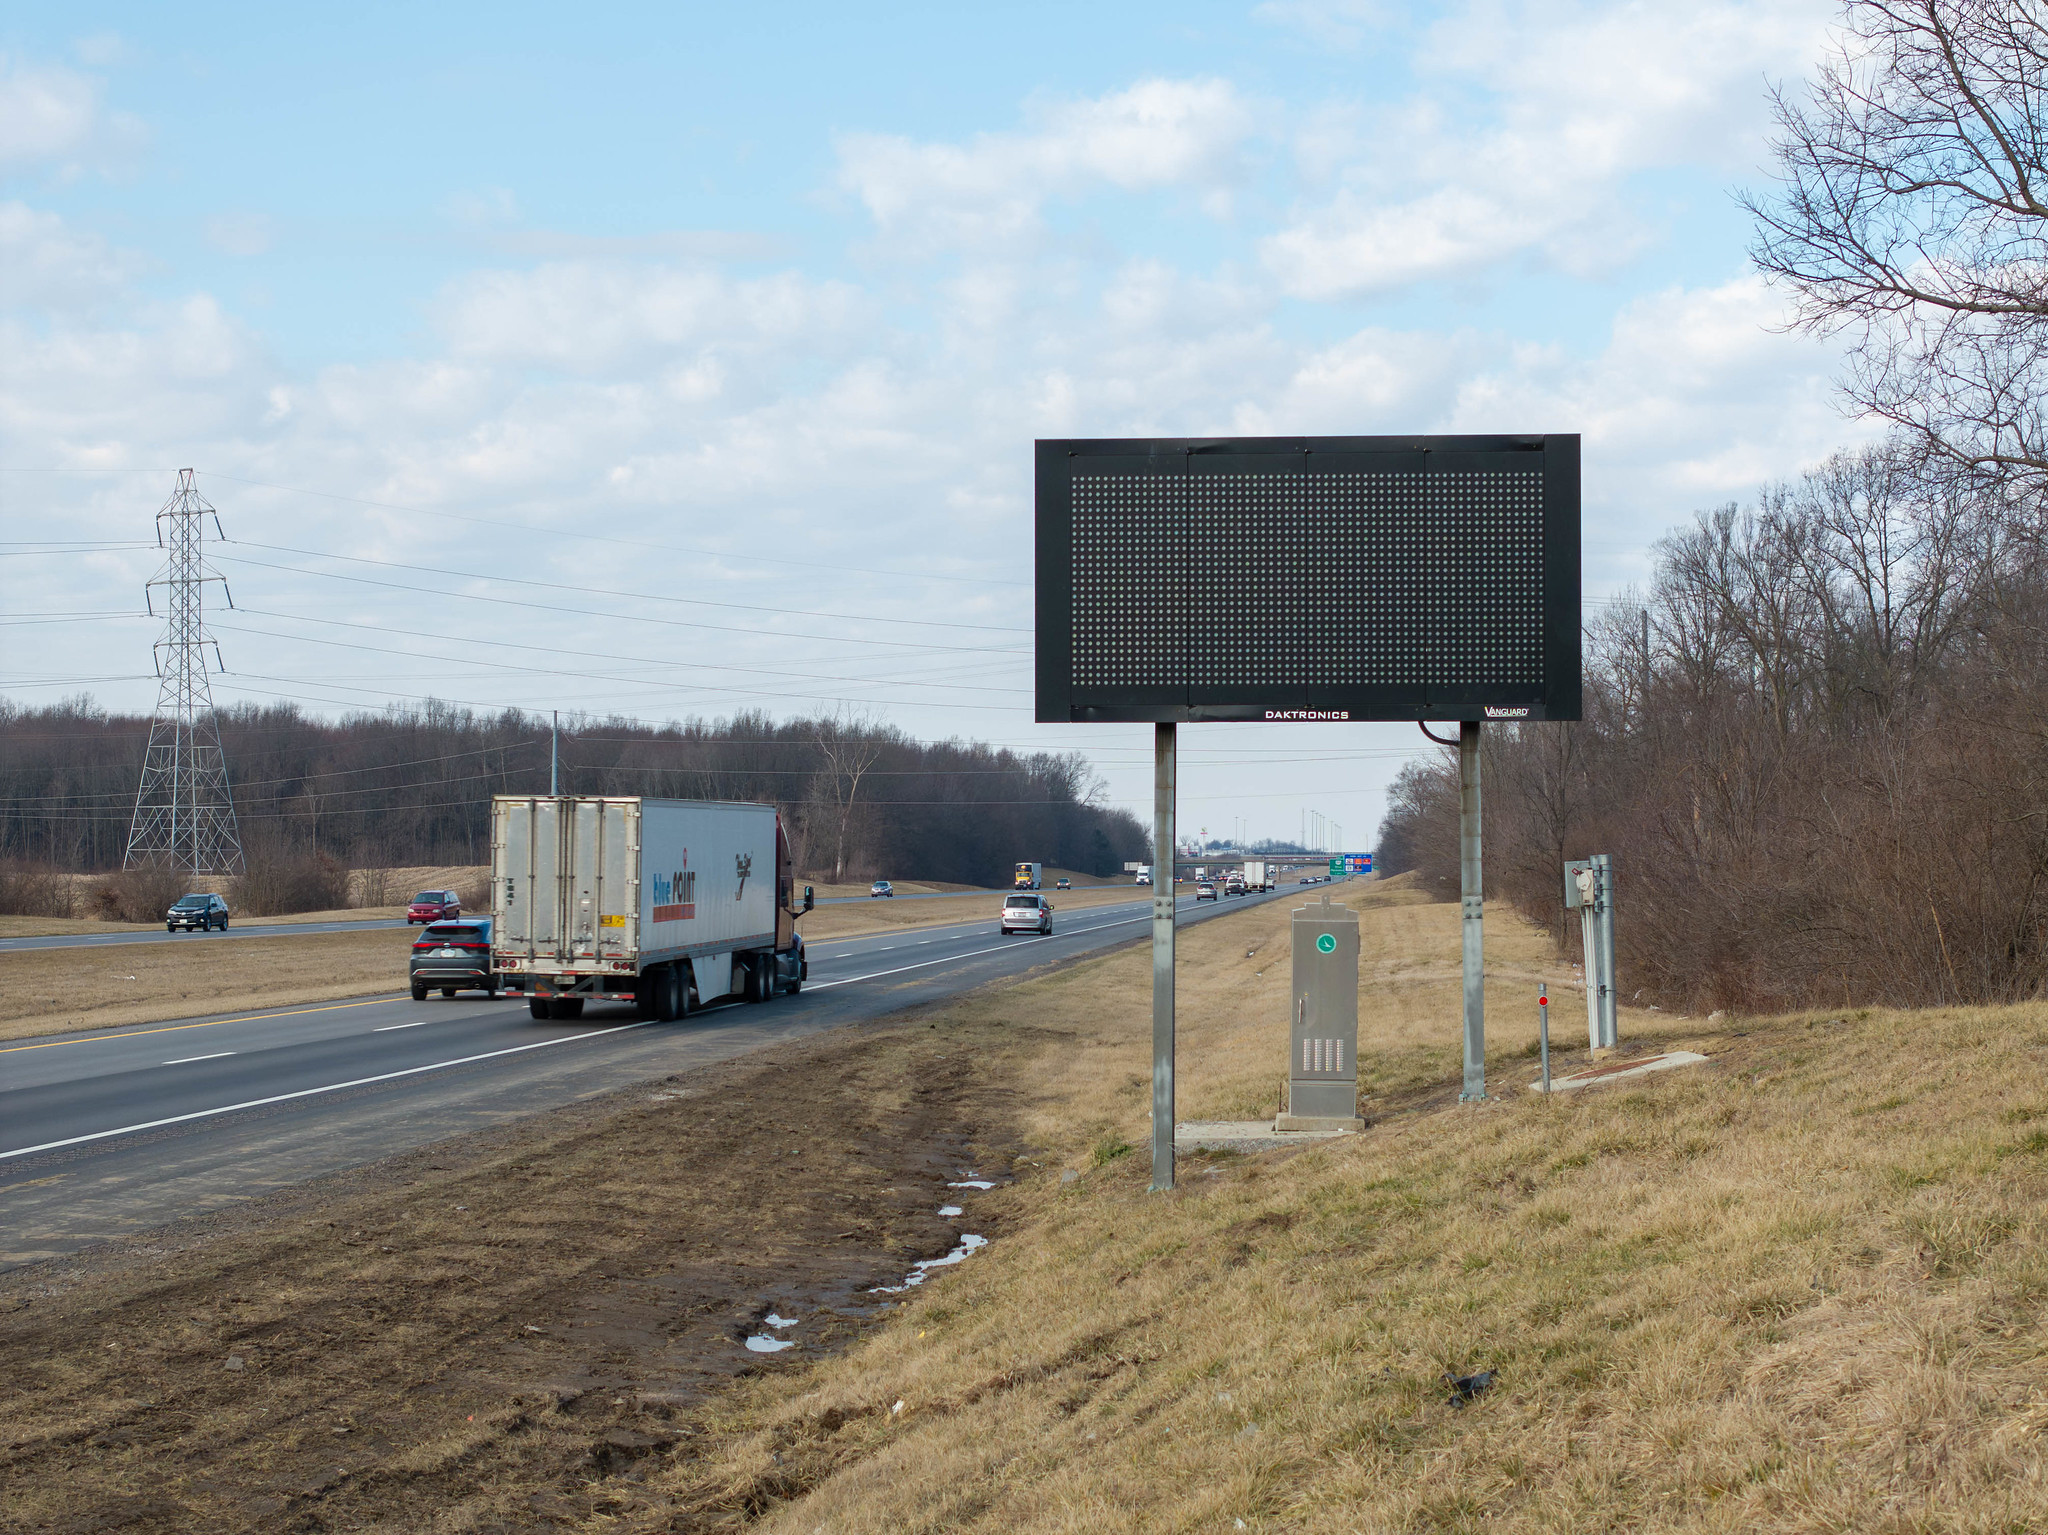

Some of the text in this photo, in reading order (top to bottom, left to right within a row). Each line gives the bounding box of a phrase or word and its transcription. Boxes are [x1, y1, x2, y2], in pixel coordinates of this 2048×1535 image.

[1265, 711, 1349, 719] DAKTRONICS
[1484, 706, 1528, 717] VANGUARD
[672, 871, 696, 904] POINT
